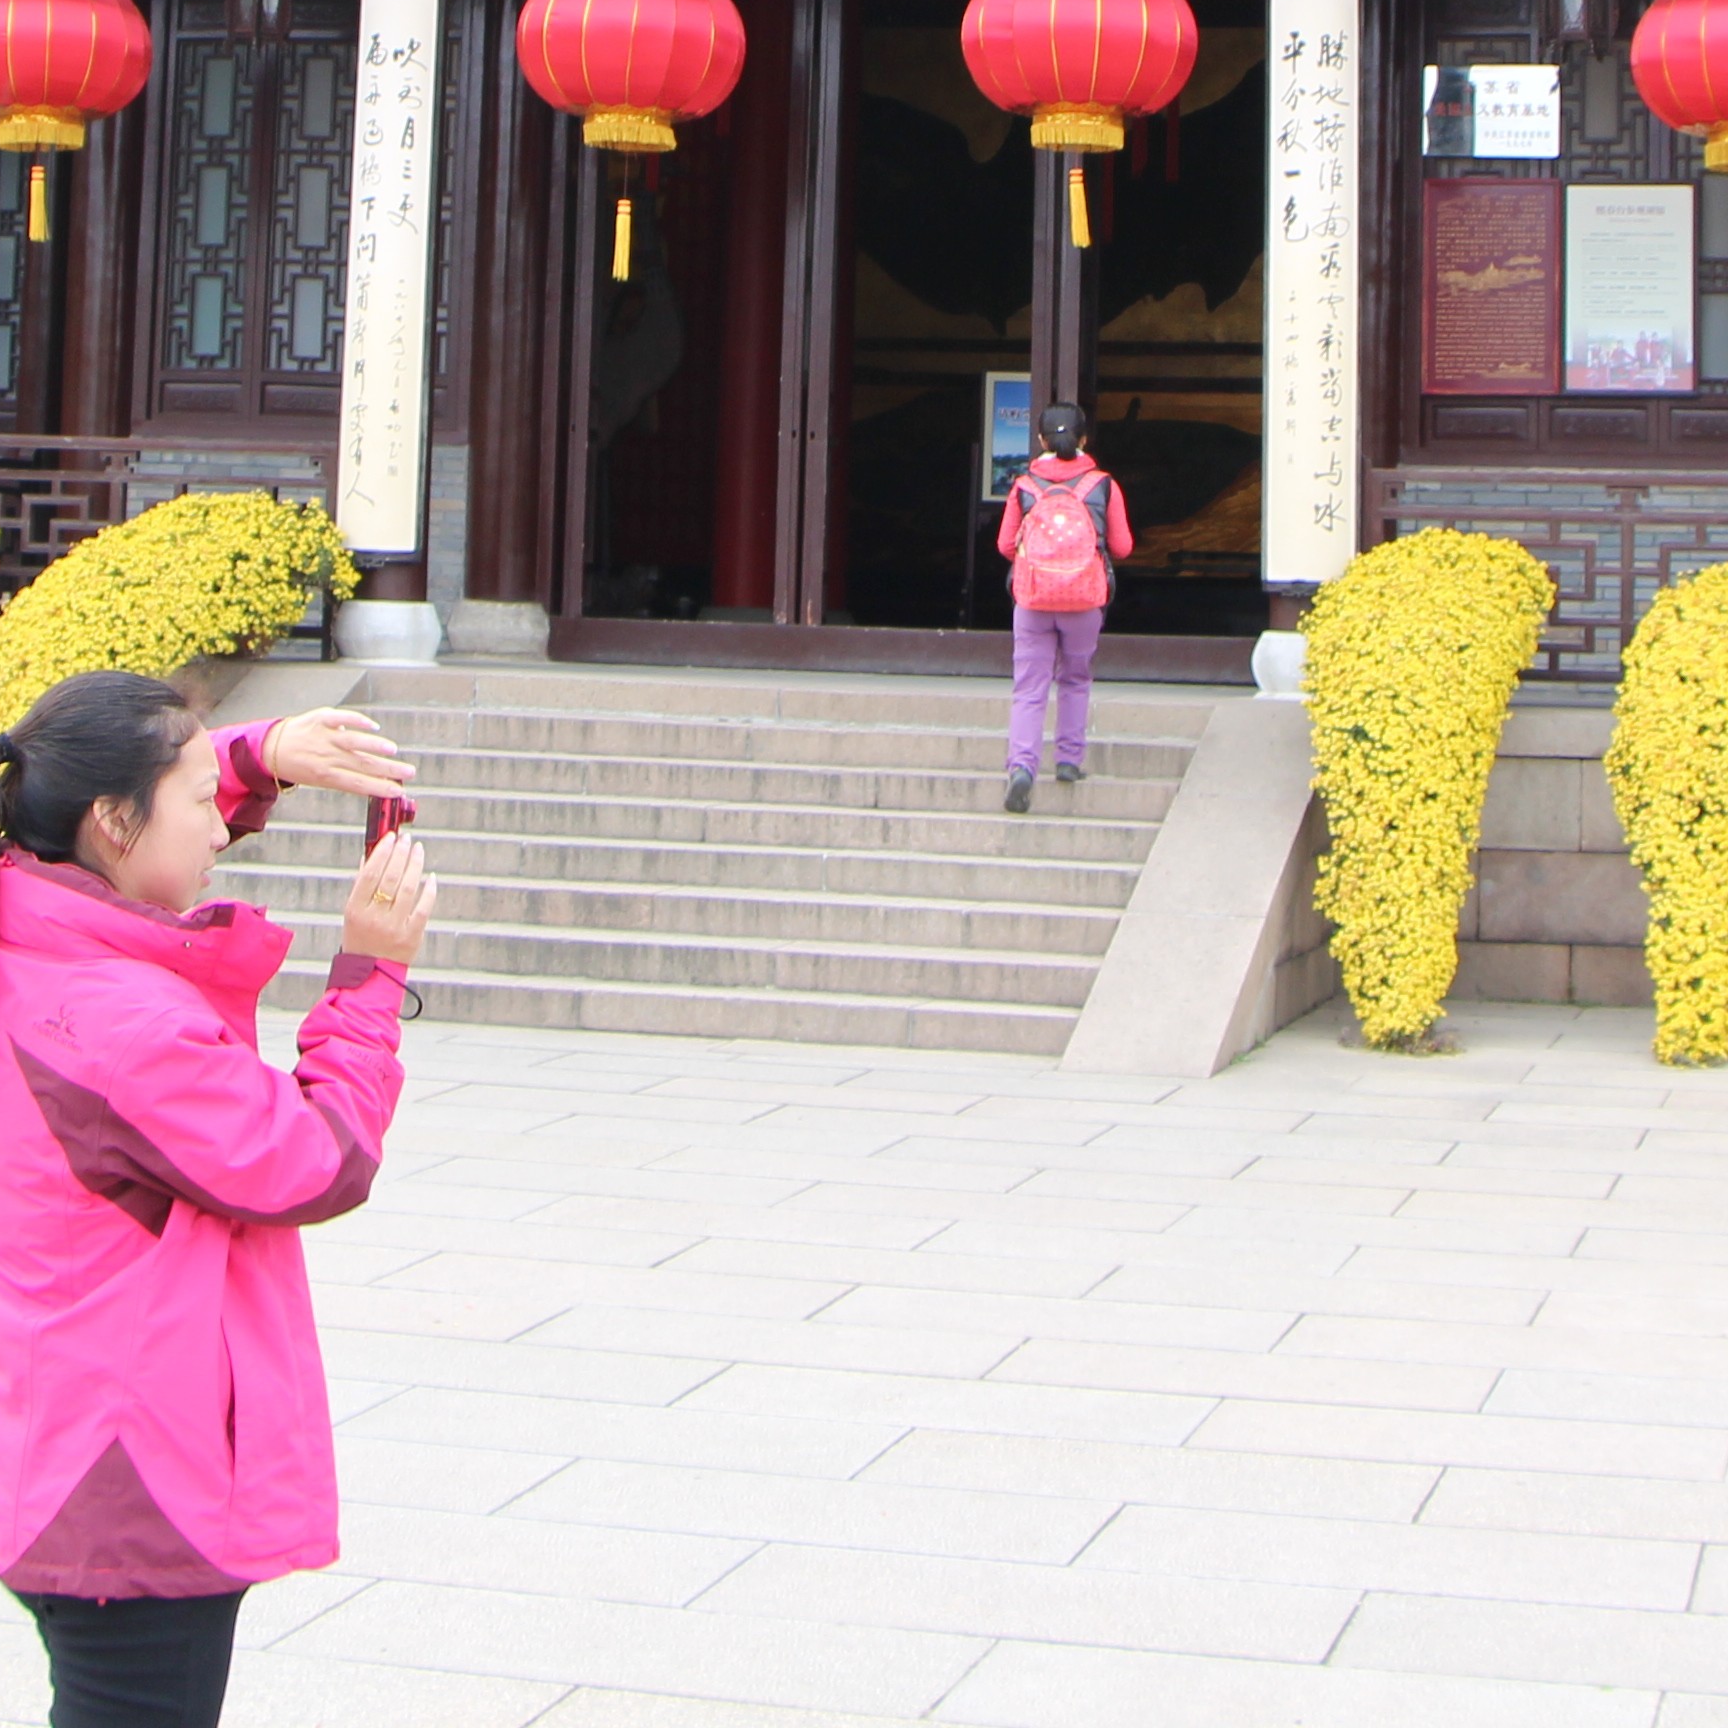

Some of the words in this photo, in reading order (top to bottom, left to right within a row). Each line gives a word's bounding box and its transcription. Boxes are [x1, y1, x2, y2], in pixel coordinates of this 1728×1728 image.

[1277, 31, 1309, 242] 平分秋一色
